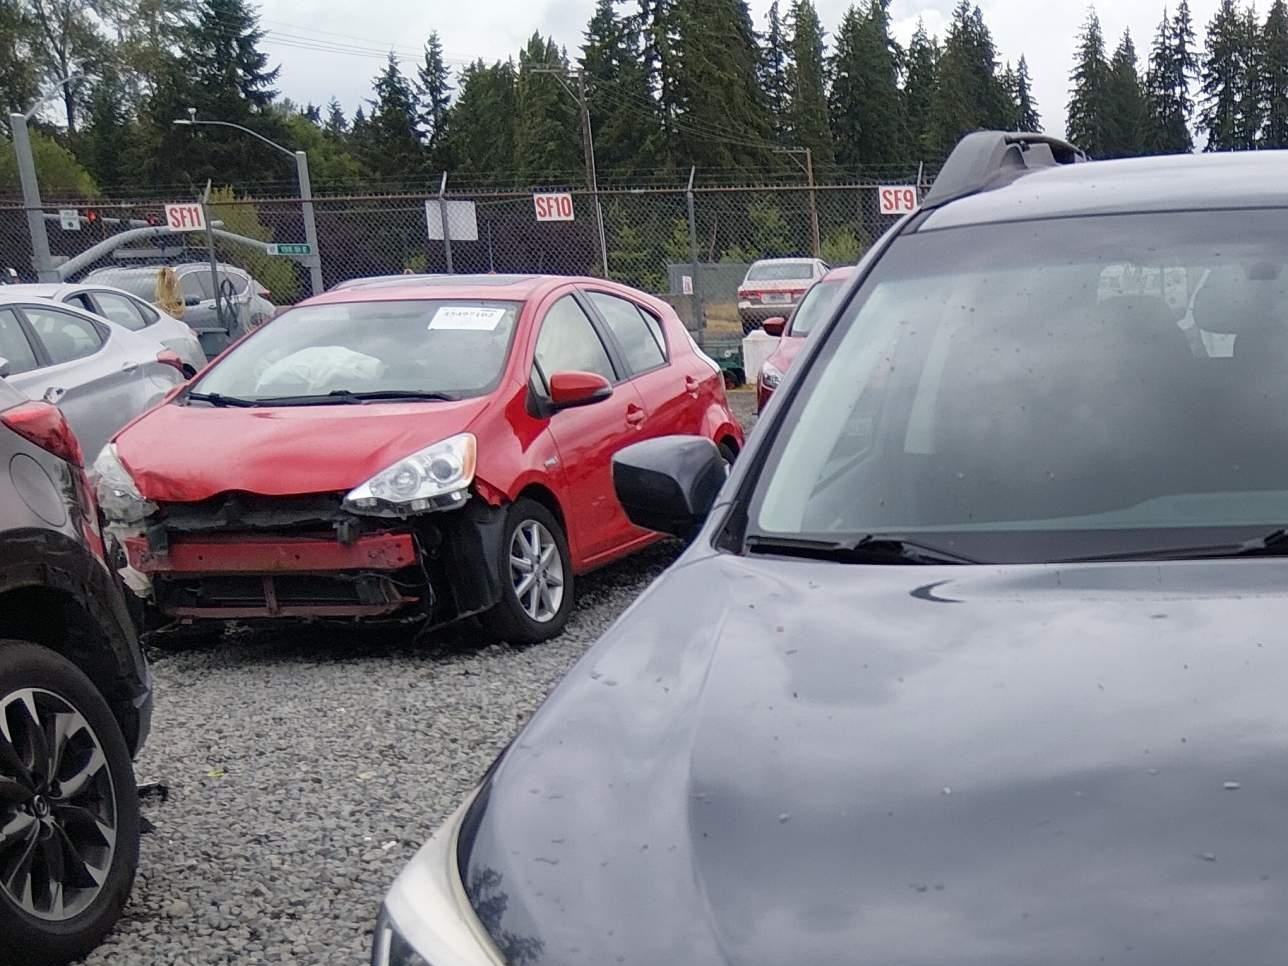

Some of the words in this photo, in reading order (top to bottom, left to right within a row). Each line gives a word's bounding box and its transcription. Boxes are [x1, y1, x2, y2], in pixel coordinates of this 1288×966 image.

[536, 196, 572, 218] SF10
[882, 189, 914, 211] SF9
[169, 207, 202, 228] SF11
